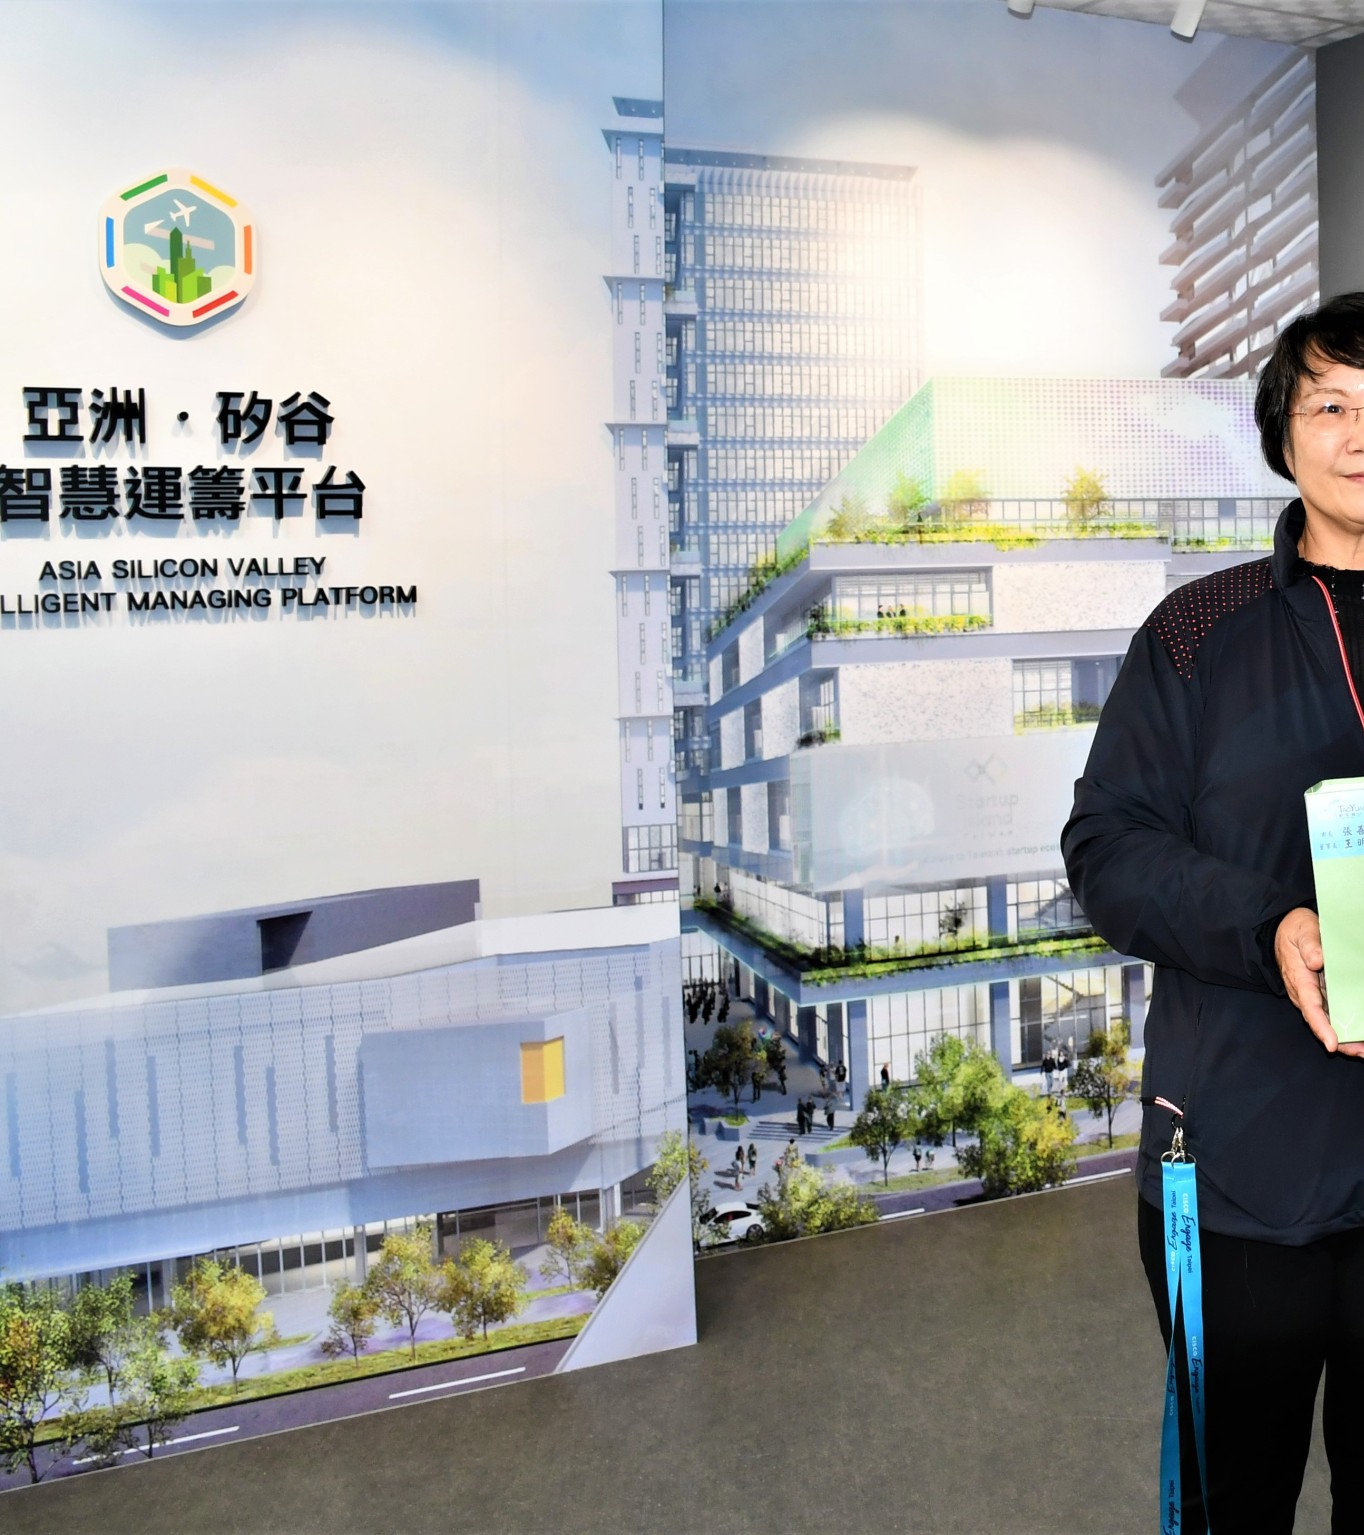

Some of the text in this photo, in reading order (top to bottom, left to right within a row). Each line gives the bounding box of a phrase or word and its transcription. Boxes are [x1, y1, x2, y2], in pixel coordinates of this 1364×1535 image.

[0, 465, 366, 522] 智慧運籌平台
[38, 557, 326, 581] ASIA SILICON VALLEY
[127, 587, 272, 611] MANAGING
[281, 585, 418, 606] PLATFORM
[955, 793, 1018, 812] Startup
[1007, 845, 1039, 857] startup
[1167, 1211, 1178, 1251] Engage
[1181, 1215, 1196, 1252] Engage
